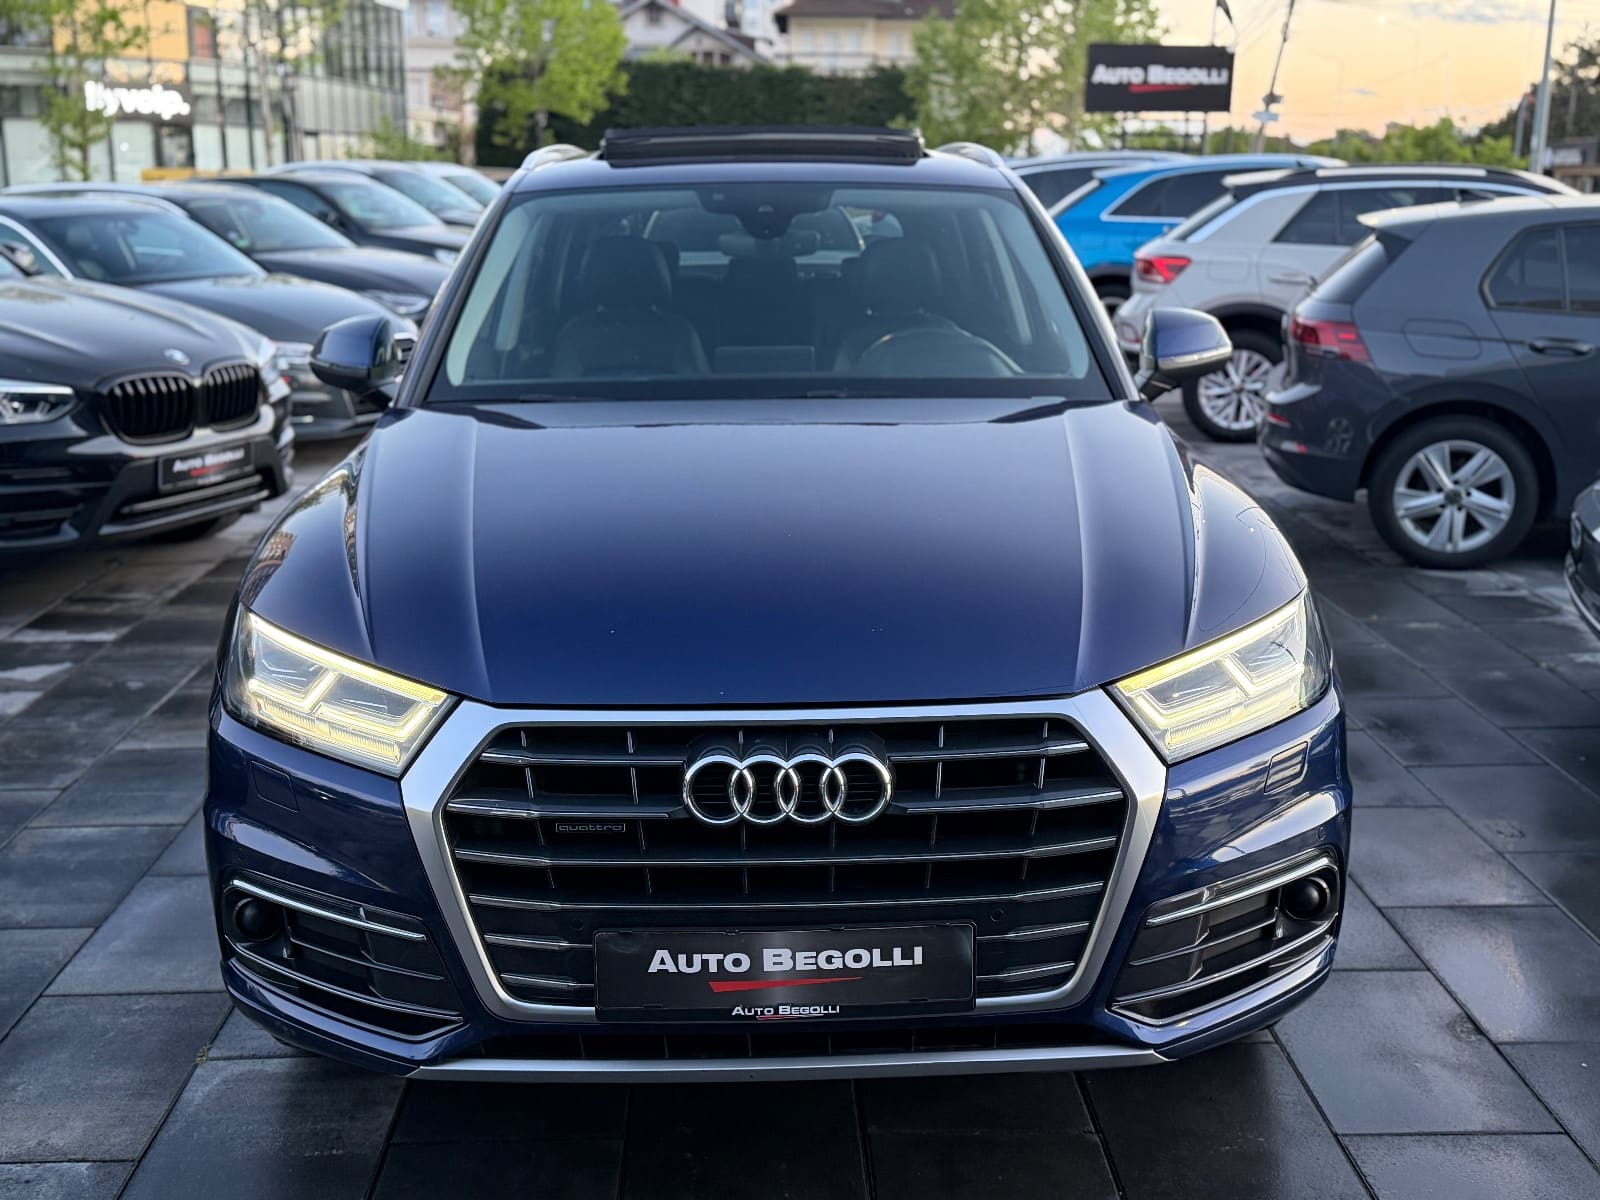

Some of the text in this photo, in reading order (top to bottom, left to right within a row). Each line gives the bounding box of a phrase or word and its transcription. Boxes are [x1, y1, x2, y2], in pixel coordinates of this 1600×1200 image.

[1091, 63, 1145, 85] AUTO
[557, 823, 624, 833] quattro
[648, 946, 924, 973] AUTO BEGOLLI
[731, 1005, 840, 1016] AUTO BEGOLLI
